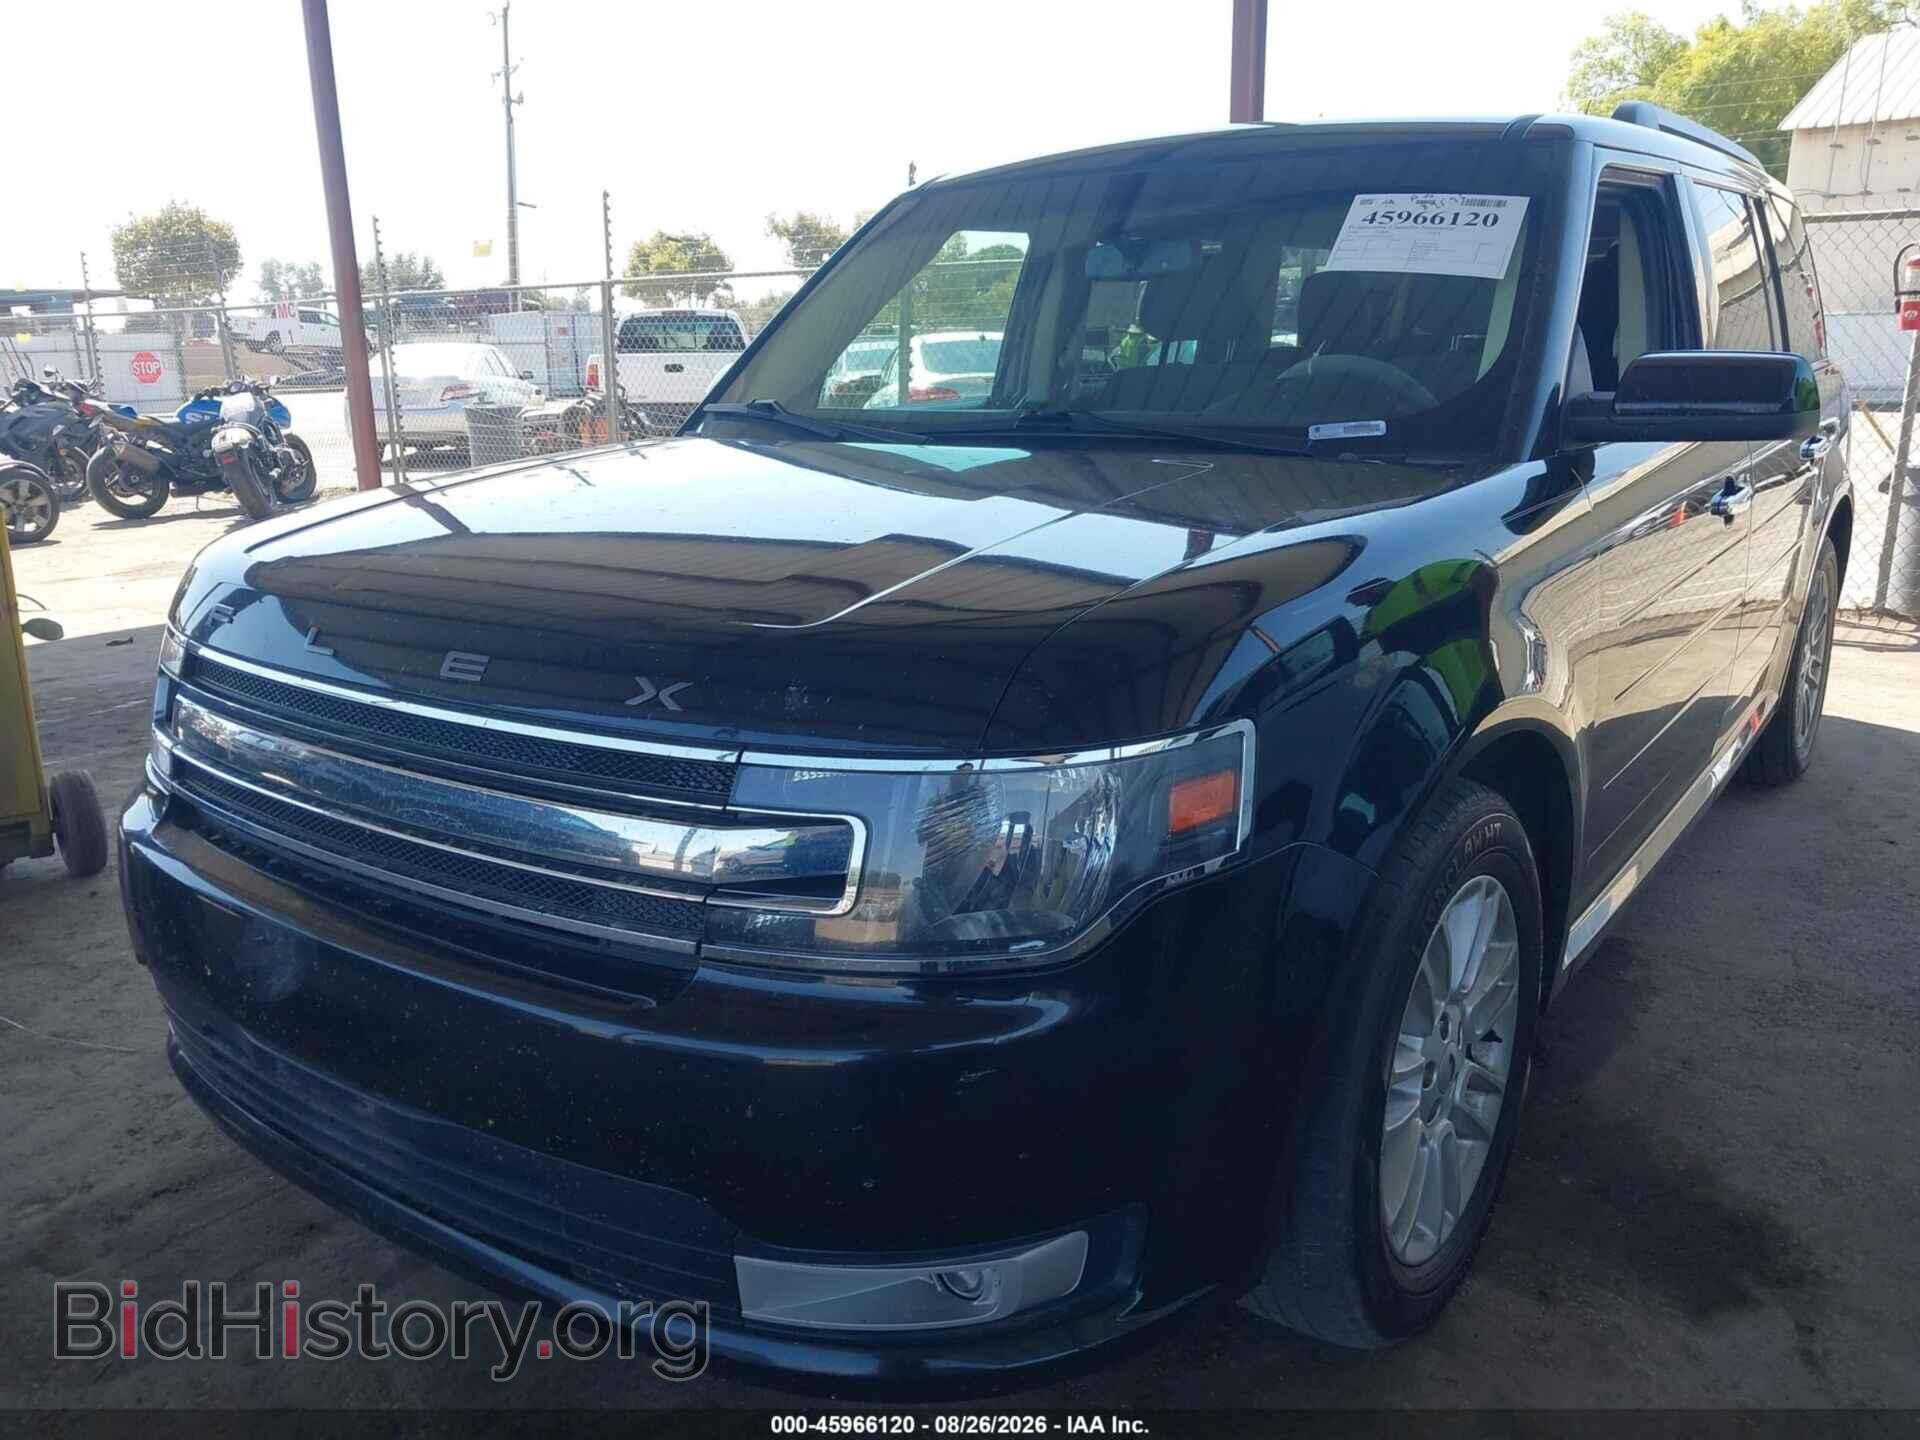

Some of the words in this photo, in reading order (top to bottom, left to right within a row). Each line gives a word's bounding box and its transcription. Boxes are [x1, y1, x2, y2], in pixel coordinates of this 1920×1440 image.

[1361, 210, 1499, 227] 45966120
[132, 361, 160, 375] STOP
[204, 603, 694, 711] FLEX
